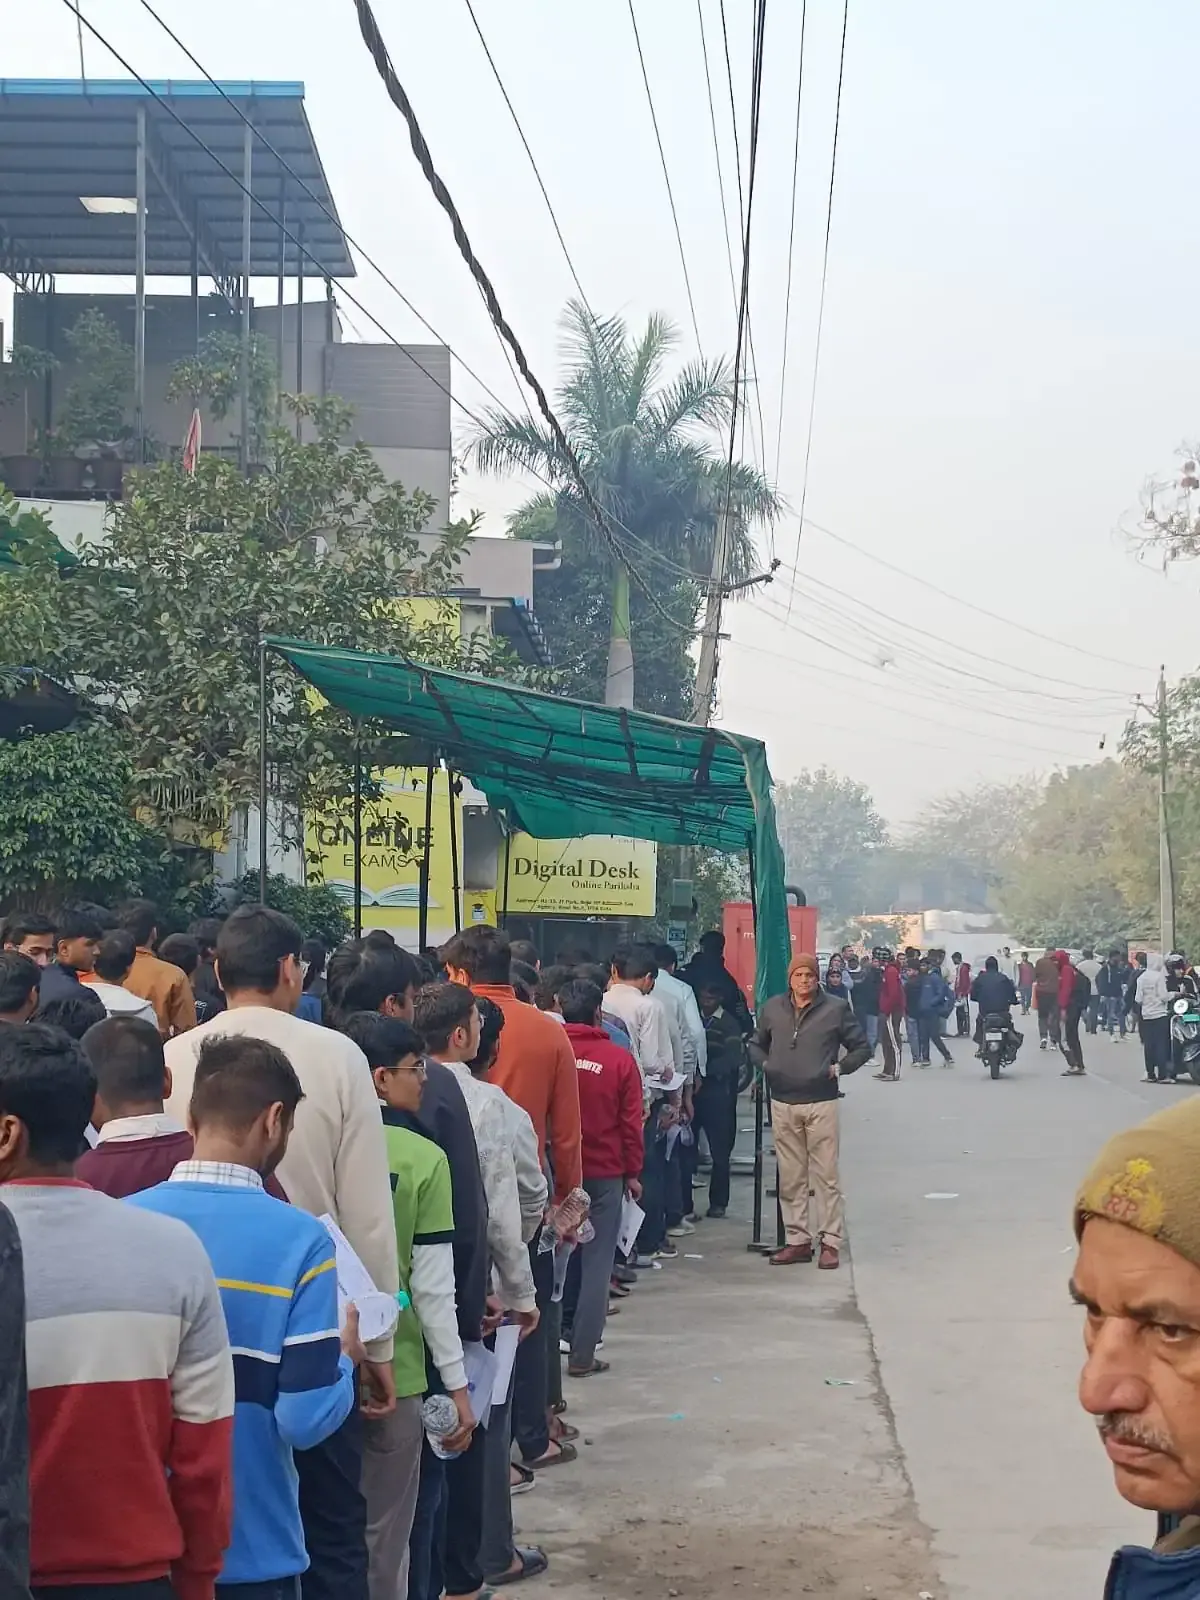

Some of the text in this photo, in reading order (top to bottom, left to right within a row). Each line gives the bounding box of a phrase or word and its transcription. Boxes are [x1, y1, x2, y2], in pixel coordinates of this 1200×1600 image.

[318, 824, 435, 847] ONLINE
[514, 857, 640, 882] Digital Desk
[571, 879, 602, 889] Online
